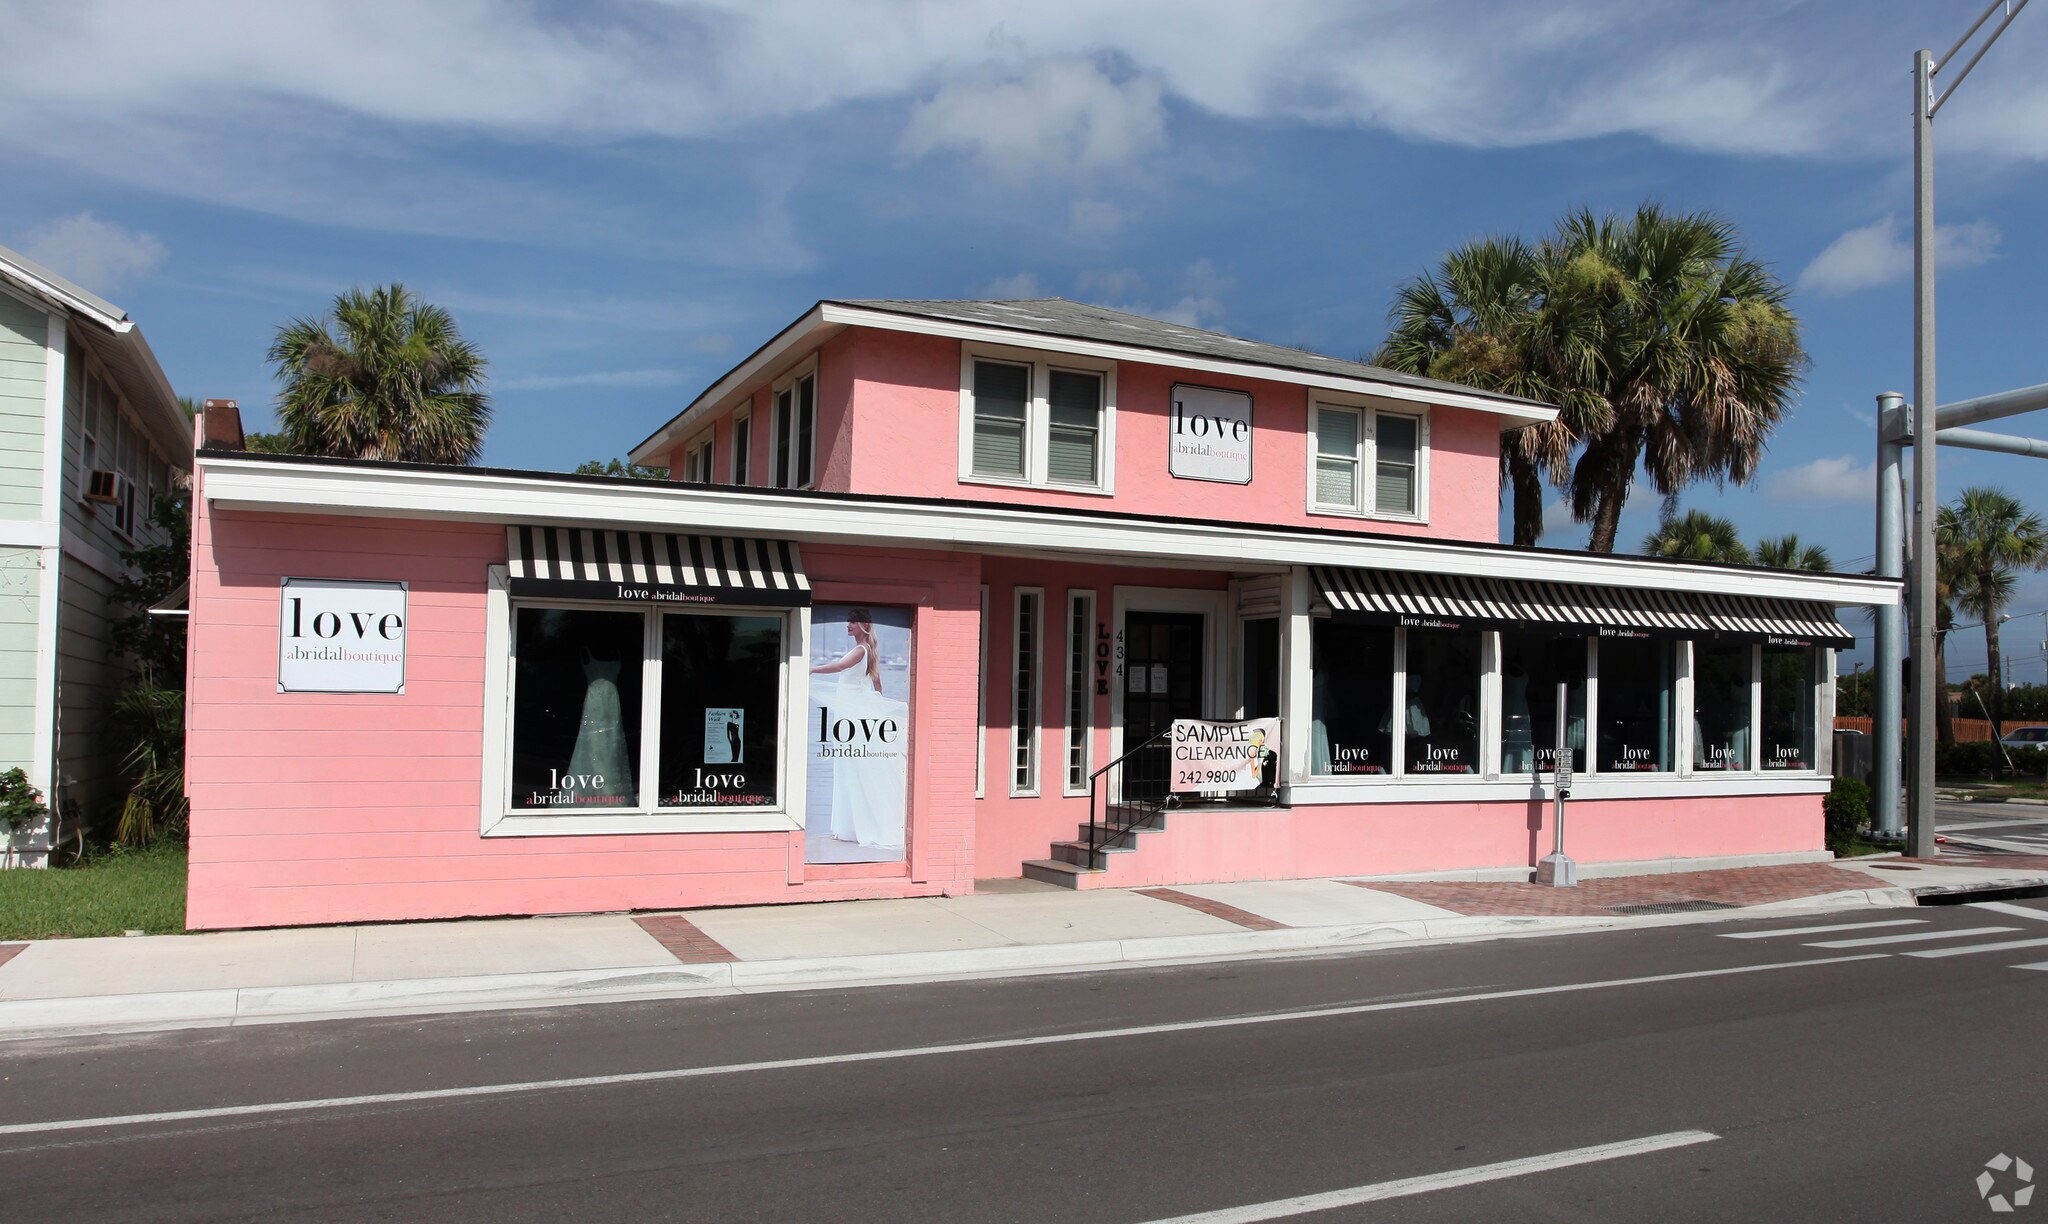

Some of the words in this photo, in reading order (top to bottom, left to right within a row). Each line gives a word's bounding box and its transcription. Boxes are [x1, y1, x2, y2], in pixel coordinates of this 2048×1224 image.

[1173, 401, 1249, 443] love
[617, 585, 649, 599] love
[287, 597, 404, 641] love
[1400, 615, 1420, 626] love
[1599, 626, 1616, 637] love
[1768, 635, 1783, 644] love
[1096, 623, 1110, 695] LOVE
[1116, 629, 1125, 677] 434
[816, 706, 898, 744] love
[1176, 724, 1250, 743] SAMPLE
[1176, 744, 1266, 761] CLEARANCE
[1334, 743, 1369, 761] love
[1426, 743, 1459, 761] love
[1623, 744, 1650, 760] love
[1710, 744, 1735, 759] love
[1776, 744, 1799, 758] love
[549, 768, 605, 790] love
[693, 767, 746, 789] love
[1179, 769, 1236, 785] 242.9800
